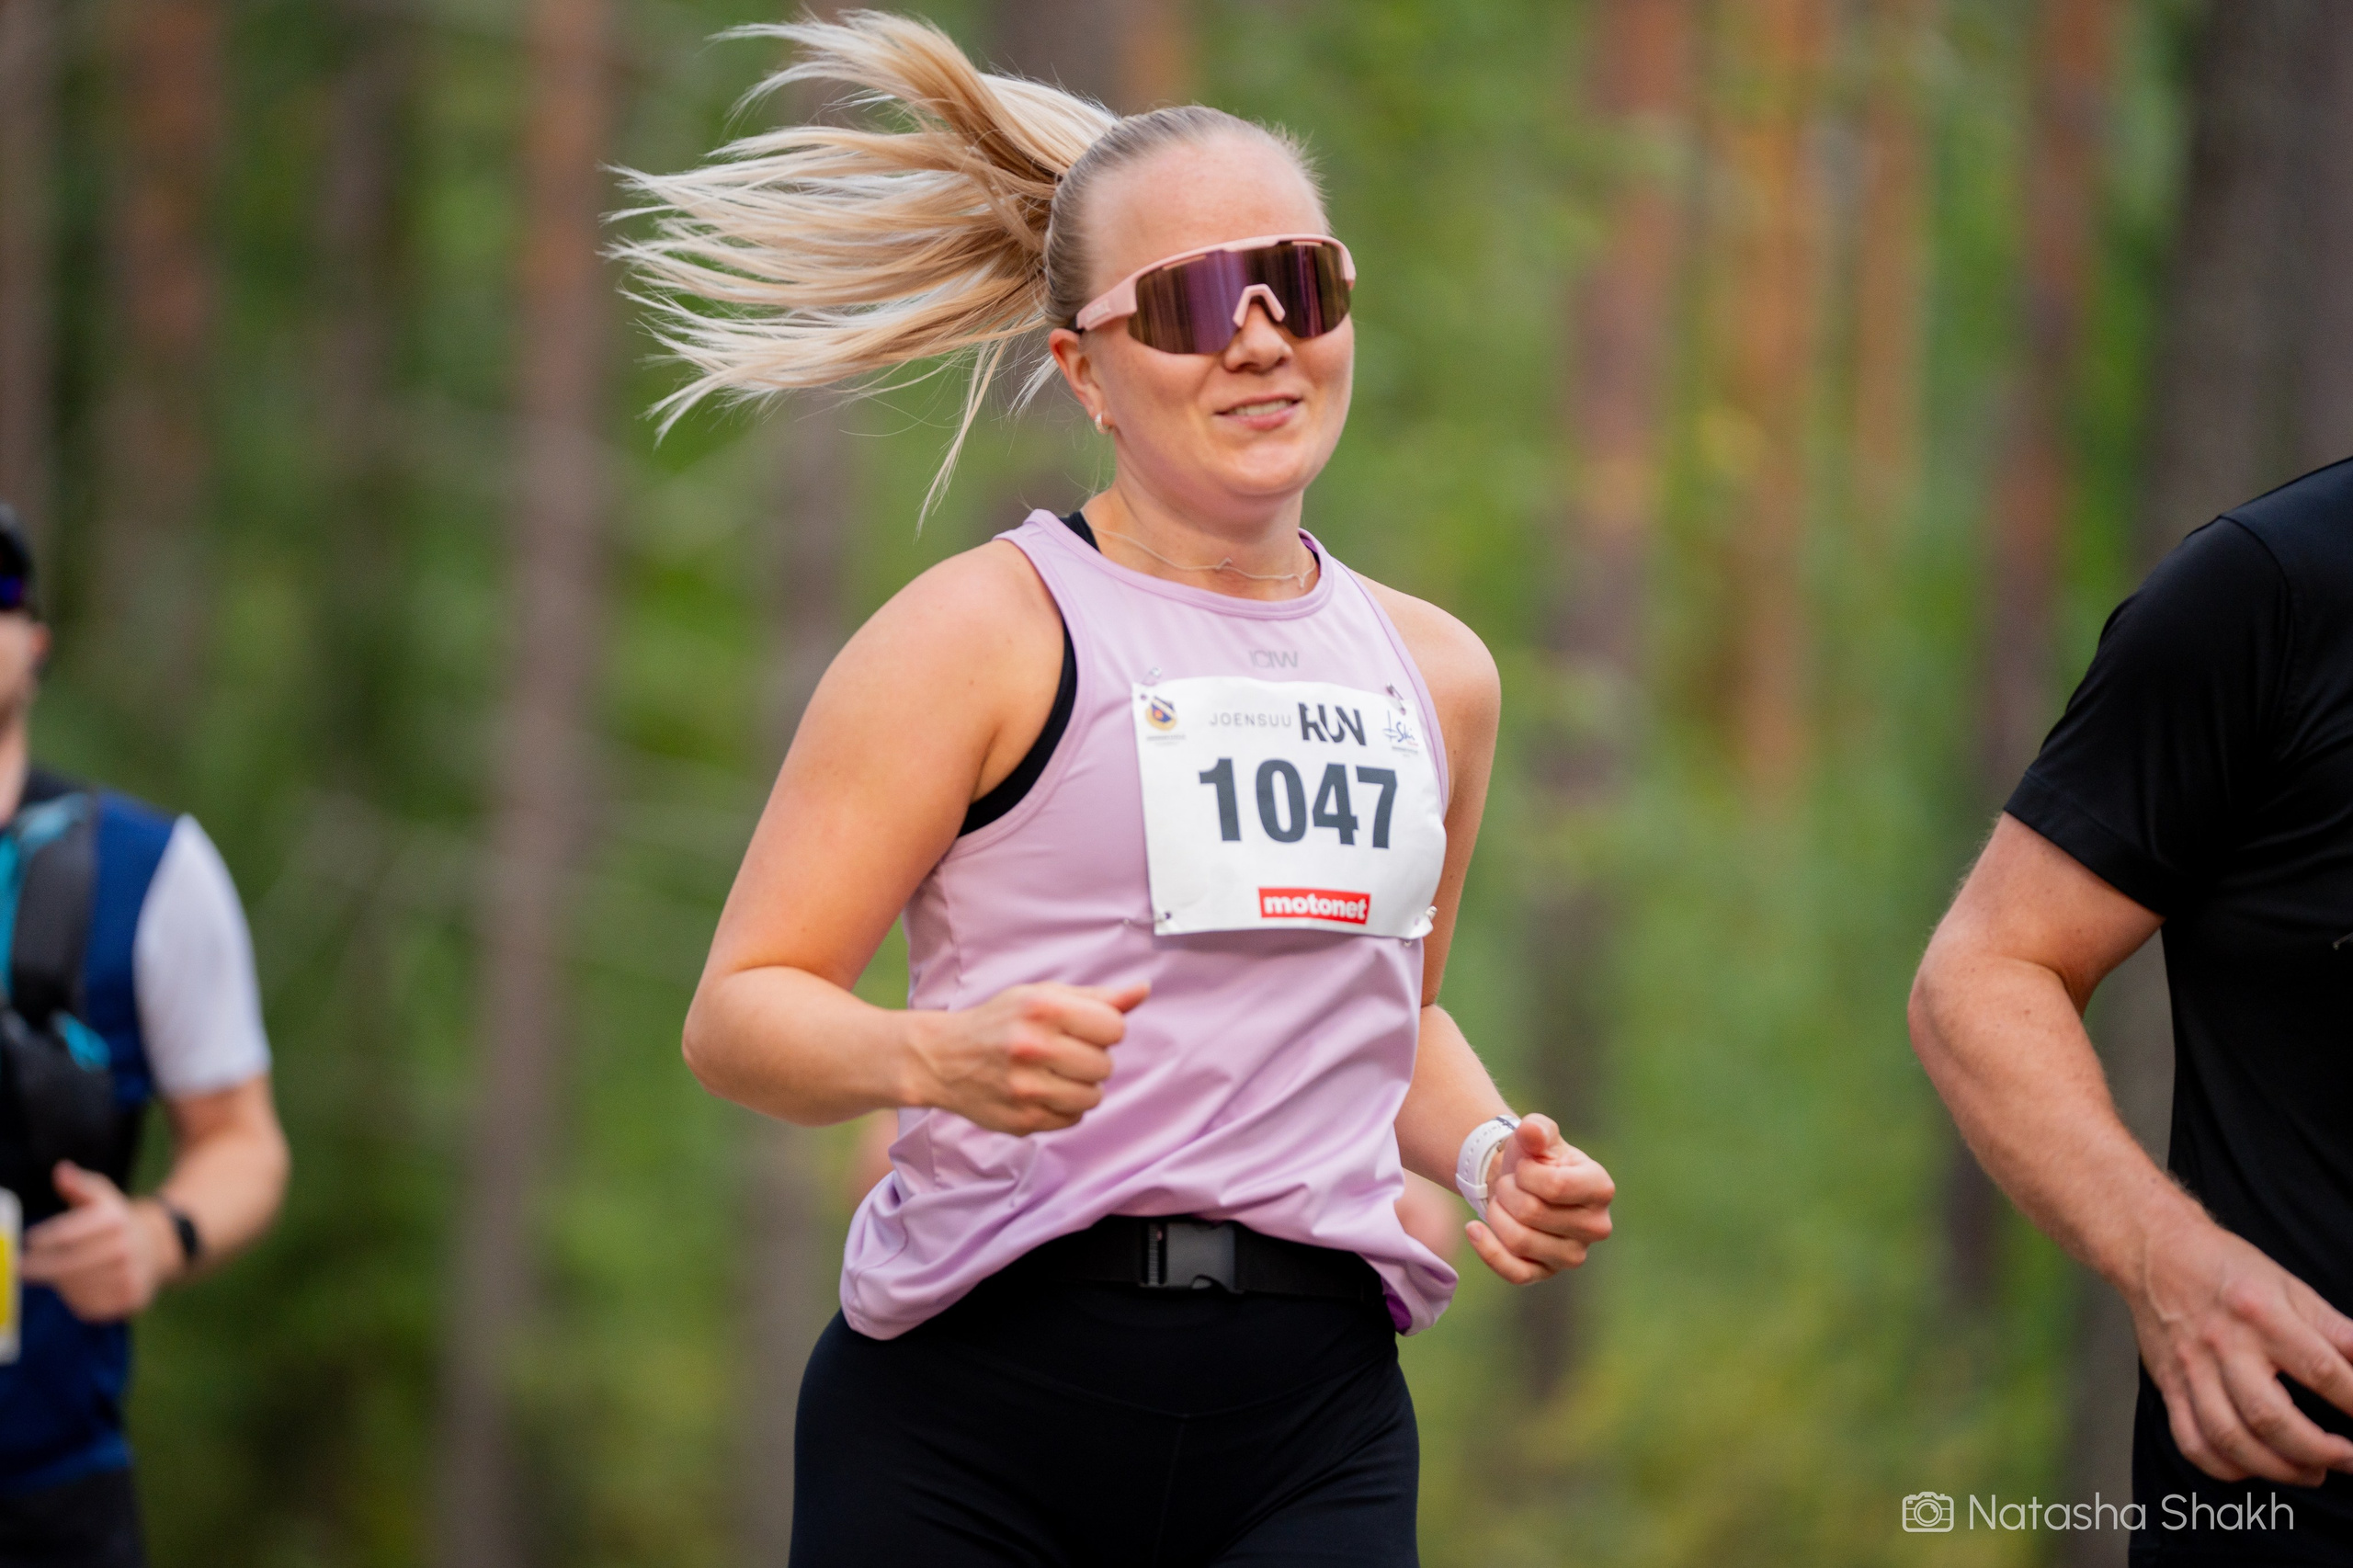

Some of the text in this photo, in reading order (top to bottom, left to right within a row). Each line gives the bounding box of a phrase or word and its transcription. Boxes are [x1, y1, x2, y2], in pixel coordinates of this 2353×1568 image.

[1209, 712, 1292, 728] JOENSUU
[1199, 757, 1398, 849] 1047
[1263, 892, 1368, 920] motonet
